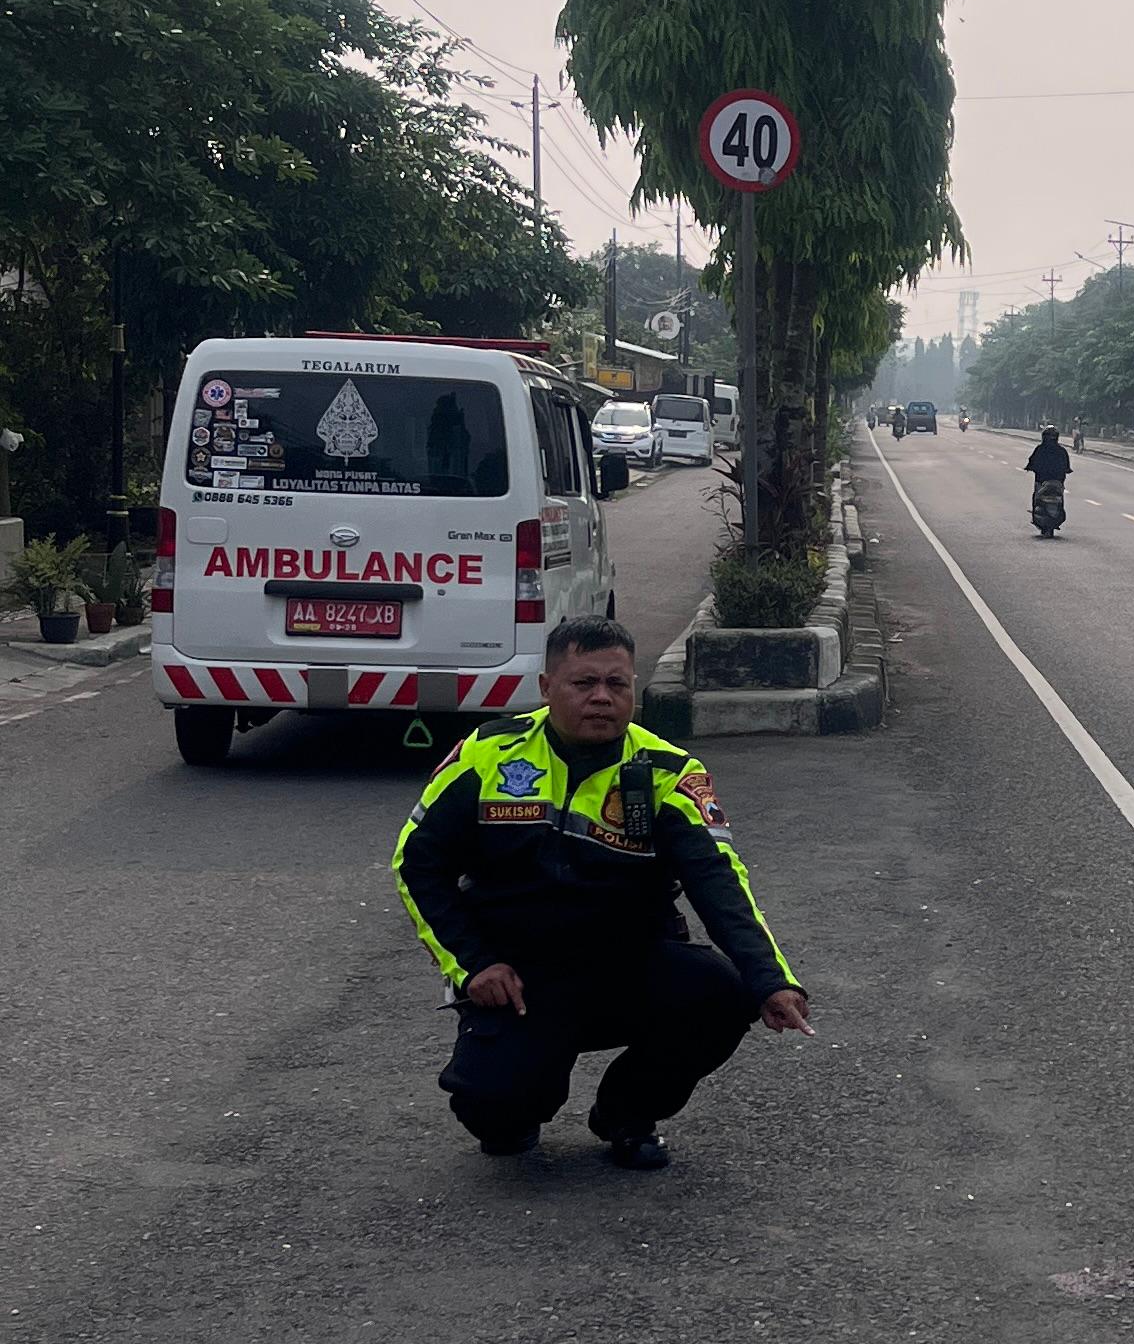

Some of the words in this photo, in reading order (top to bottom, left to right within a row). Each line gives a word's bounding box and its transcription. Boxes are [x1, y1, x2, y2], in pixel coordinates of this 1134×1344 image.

[723, 113, 778, 169] 40
[302, 360, 400, 374] TEGALARUM
[272, 478, 338, 491] LOYALITAS
[340, 480, 380, 492] TANPA
[381, 482, 421, 493] BATAS
[204, 492, 234, 503] 0888
[237, 494, 260, 504] 645
[448, 531, 472, 540] Gran
[474, 532, 495, 540] Max
[204, 546, 484, 584] AMBULANCE
[293, 602, 318, 622] AA
[326, 603, 368, 623] 8247
[371, 605, 394, 624] XB
[489, 805, 540, 818] SUKISNO
